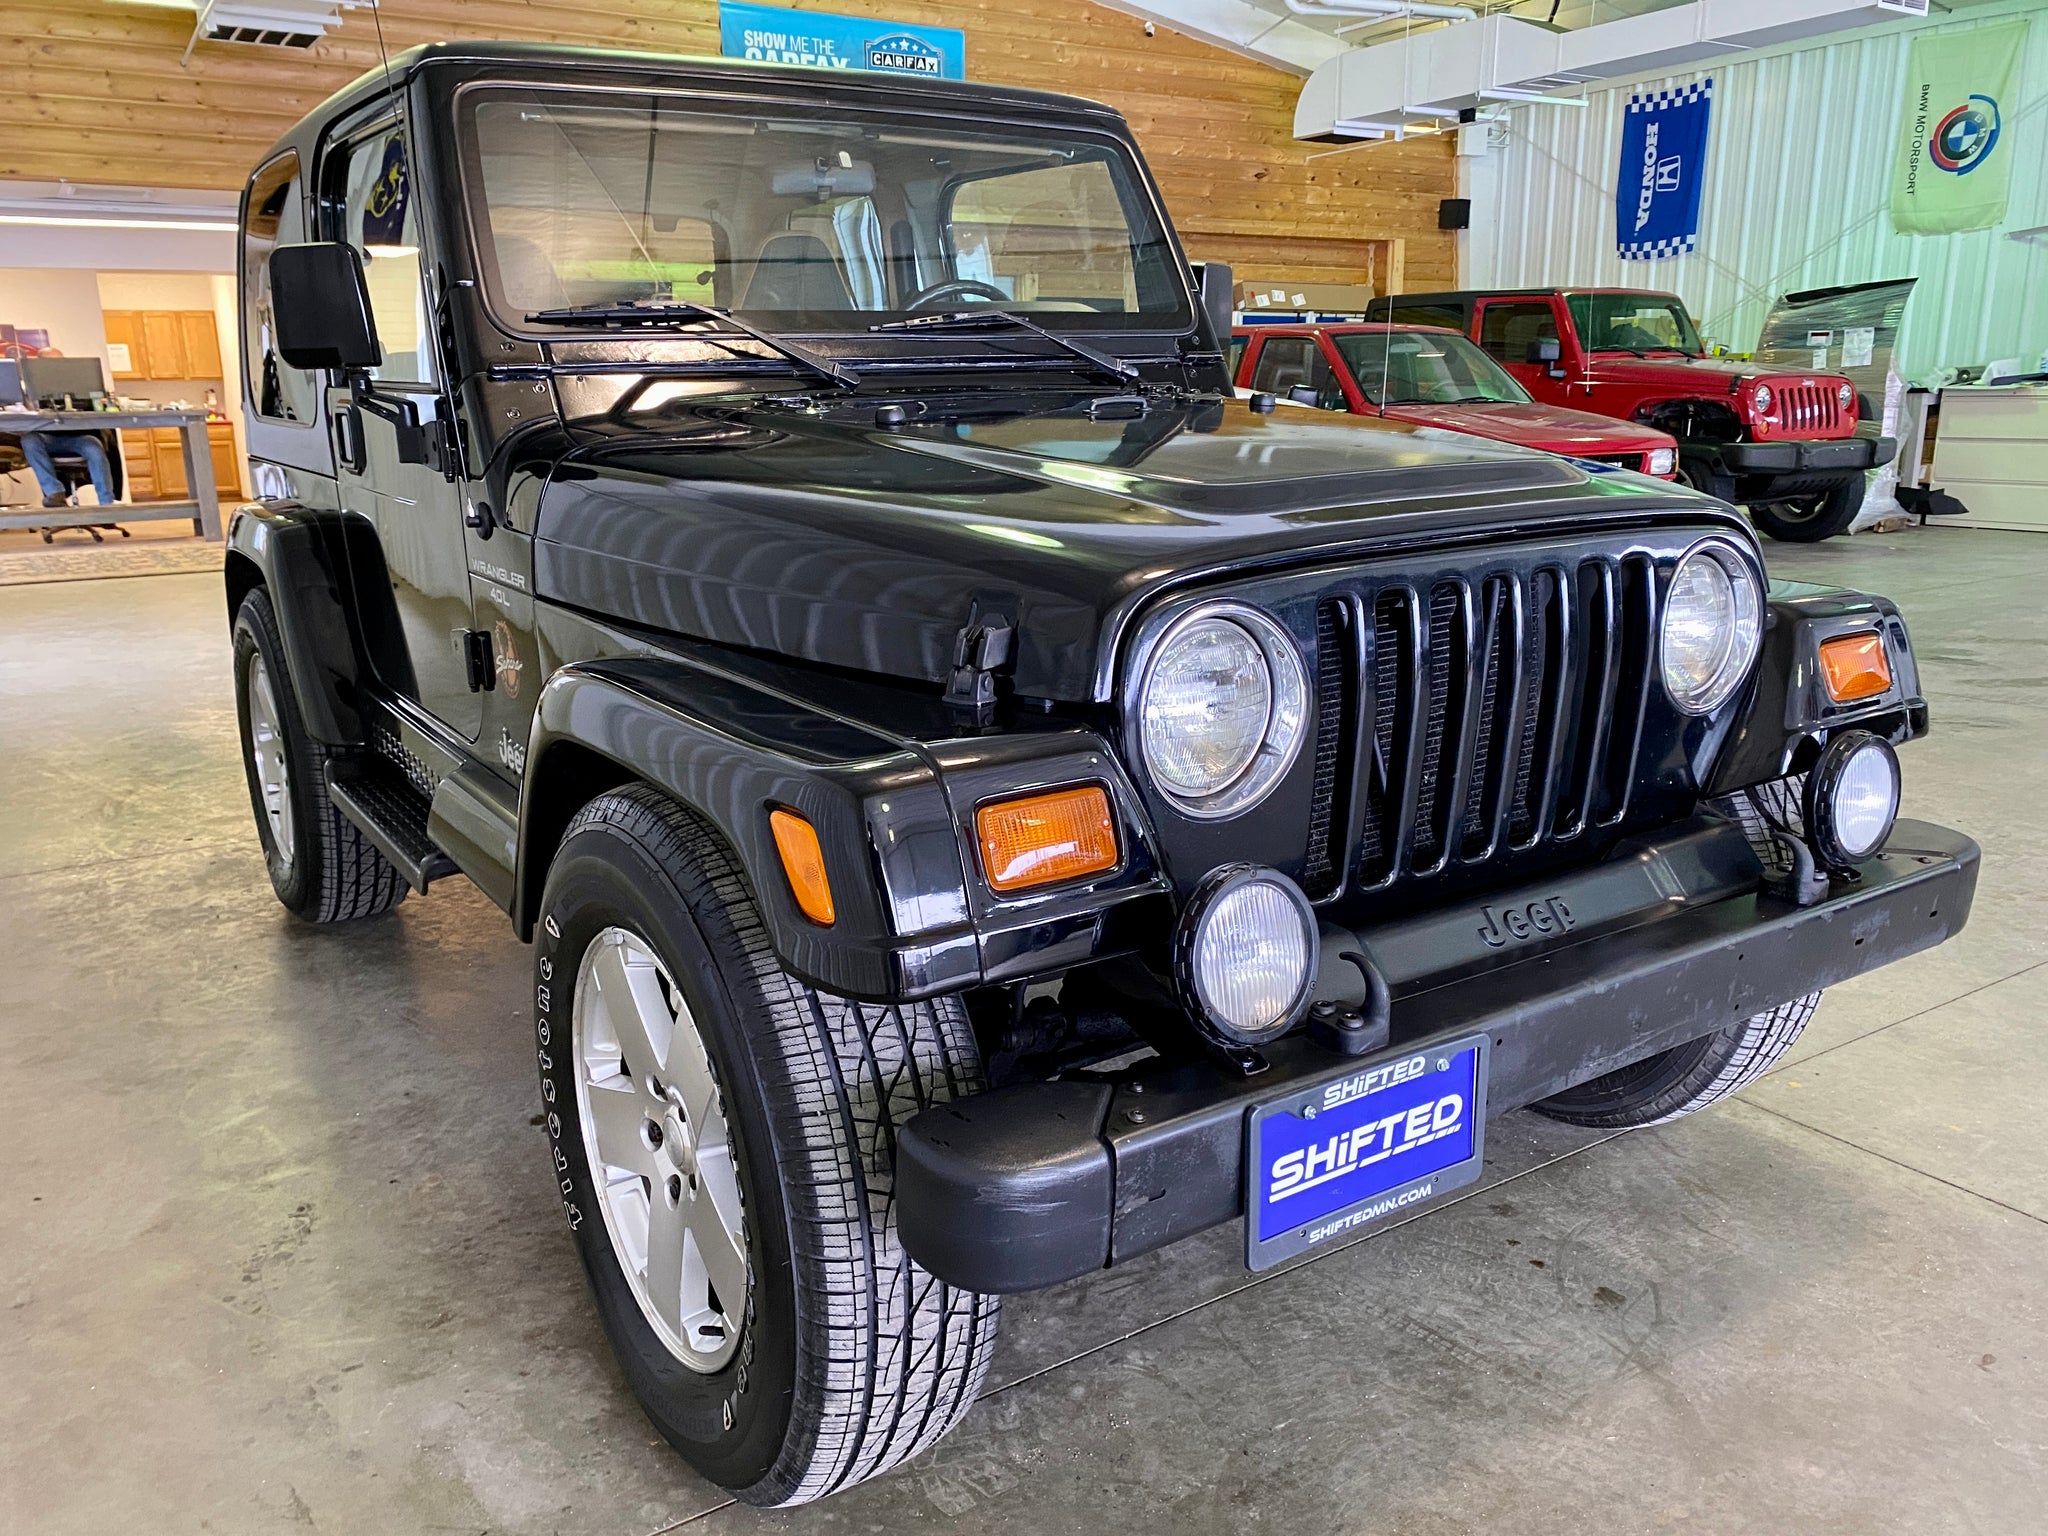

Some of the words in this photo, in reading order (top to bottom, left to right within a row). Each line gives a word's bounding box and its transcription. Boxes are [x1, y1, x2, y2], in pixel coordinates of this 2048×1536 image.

[744, 29, 787, 50] SHOW
[789, 36, 809, 54] ME
[812, 38, 835, 56] THE
[873, 53, 935, 72] CARFAX
[1918, 83, 1931, 112] BMW
[1634, 122, 1659, 232] HONDA
[1906, 115, 1928, 196] MOTORSPORT
[471, 558, 526, 589] WRANGLER
[1477, 896, 1576, 948] Jeep
[537, 956, 584, 1231] Firestone
[1308, 1183, 1432, 1244] SHIFTEDMN.COM
